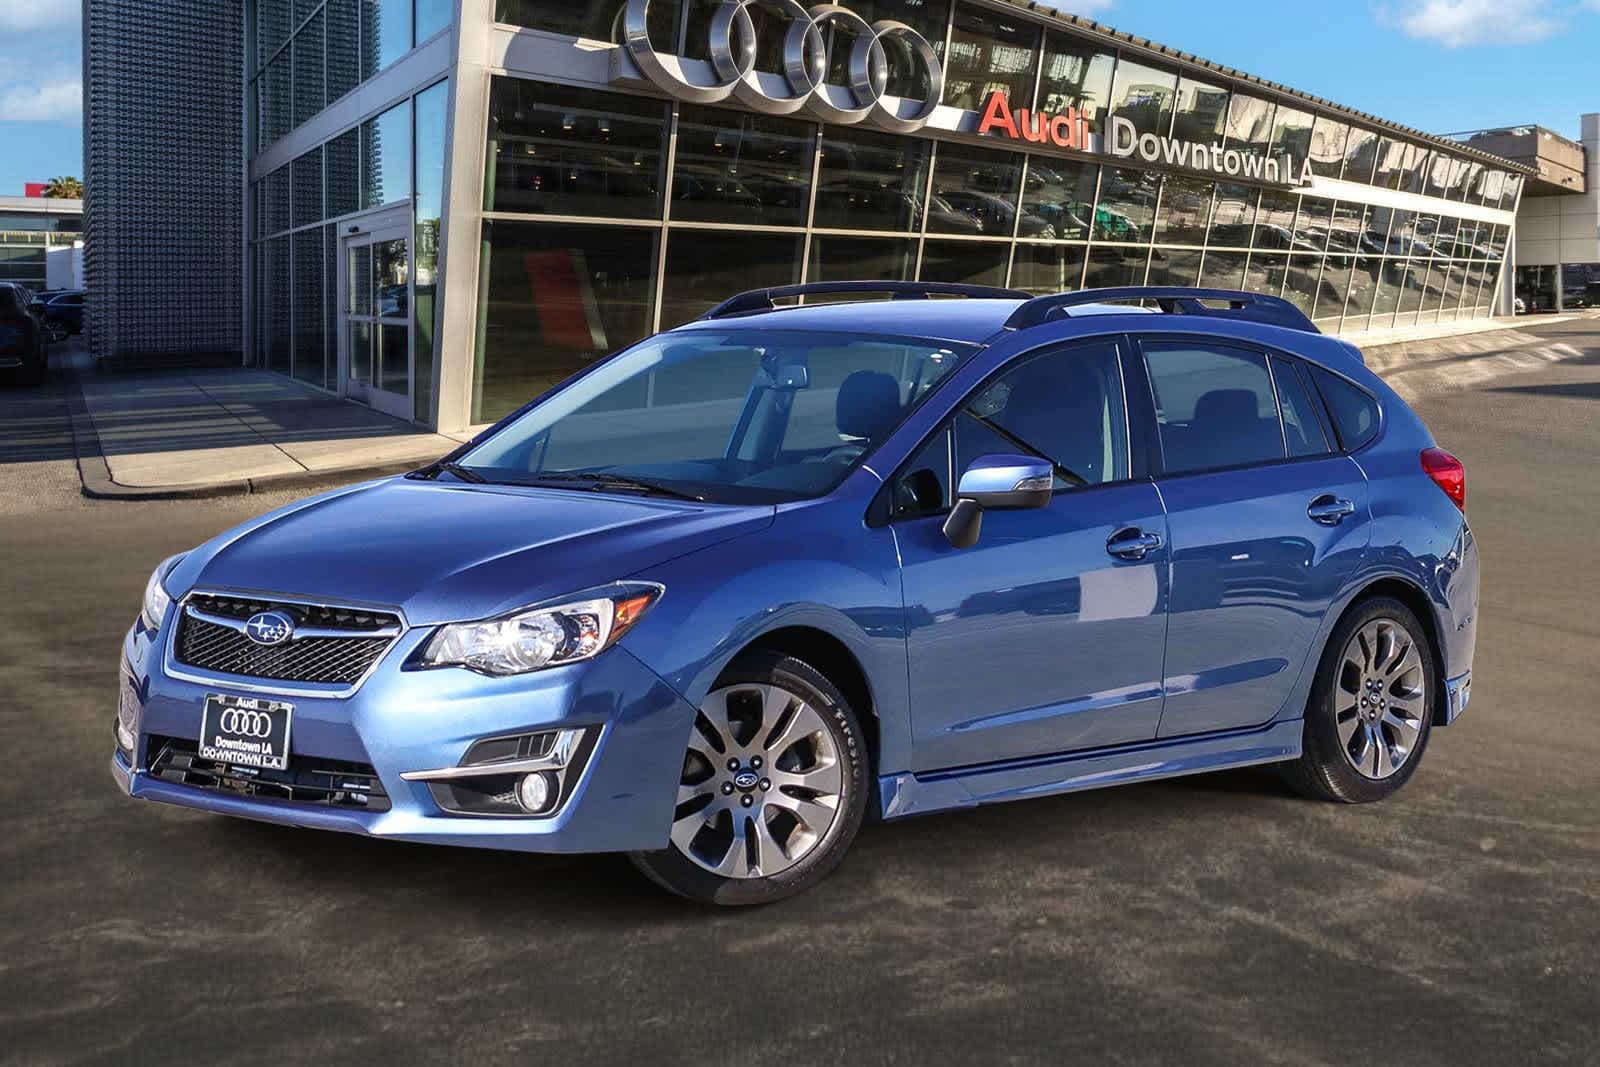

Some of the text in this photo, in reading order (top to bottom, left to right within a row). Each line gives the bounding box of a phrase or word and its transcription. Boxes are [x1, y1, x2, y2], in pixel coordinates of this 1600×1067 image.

[978, 91, 1315, 189] Audi Downtown LA
[236, 696, 258, 709] Audi
[215, 735, 273, 755] Downtown LA
[203, 746, 261, 766] DOWNTOWN
